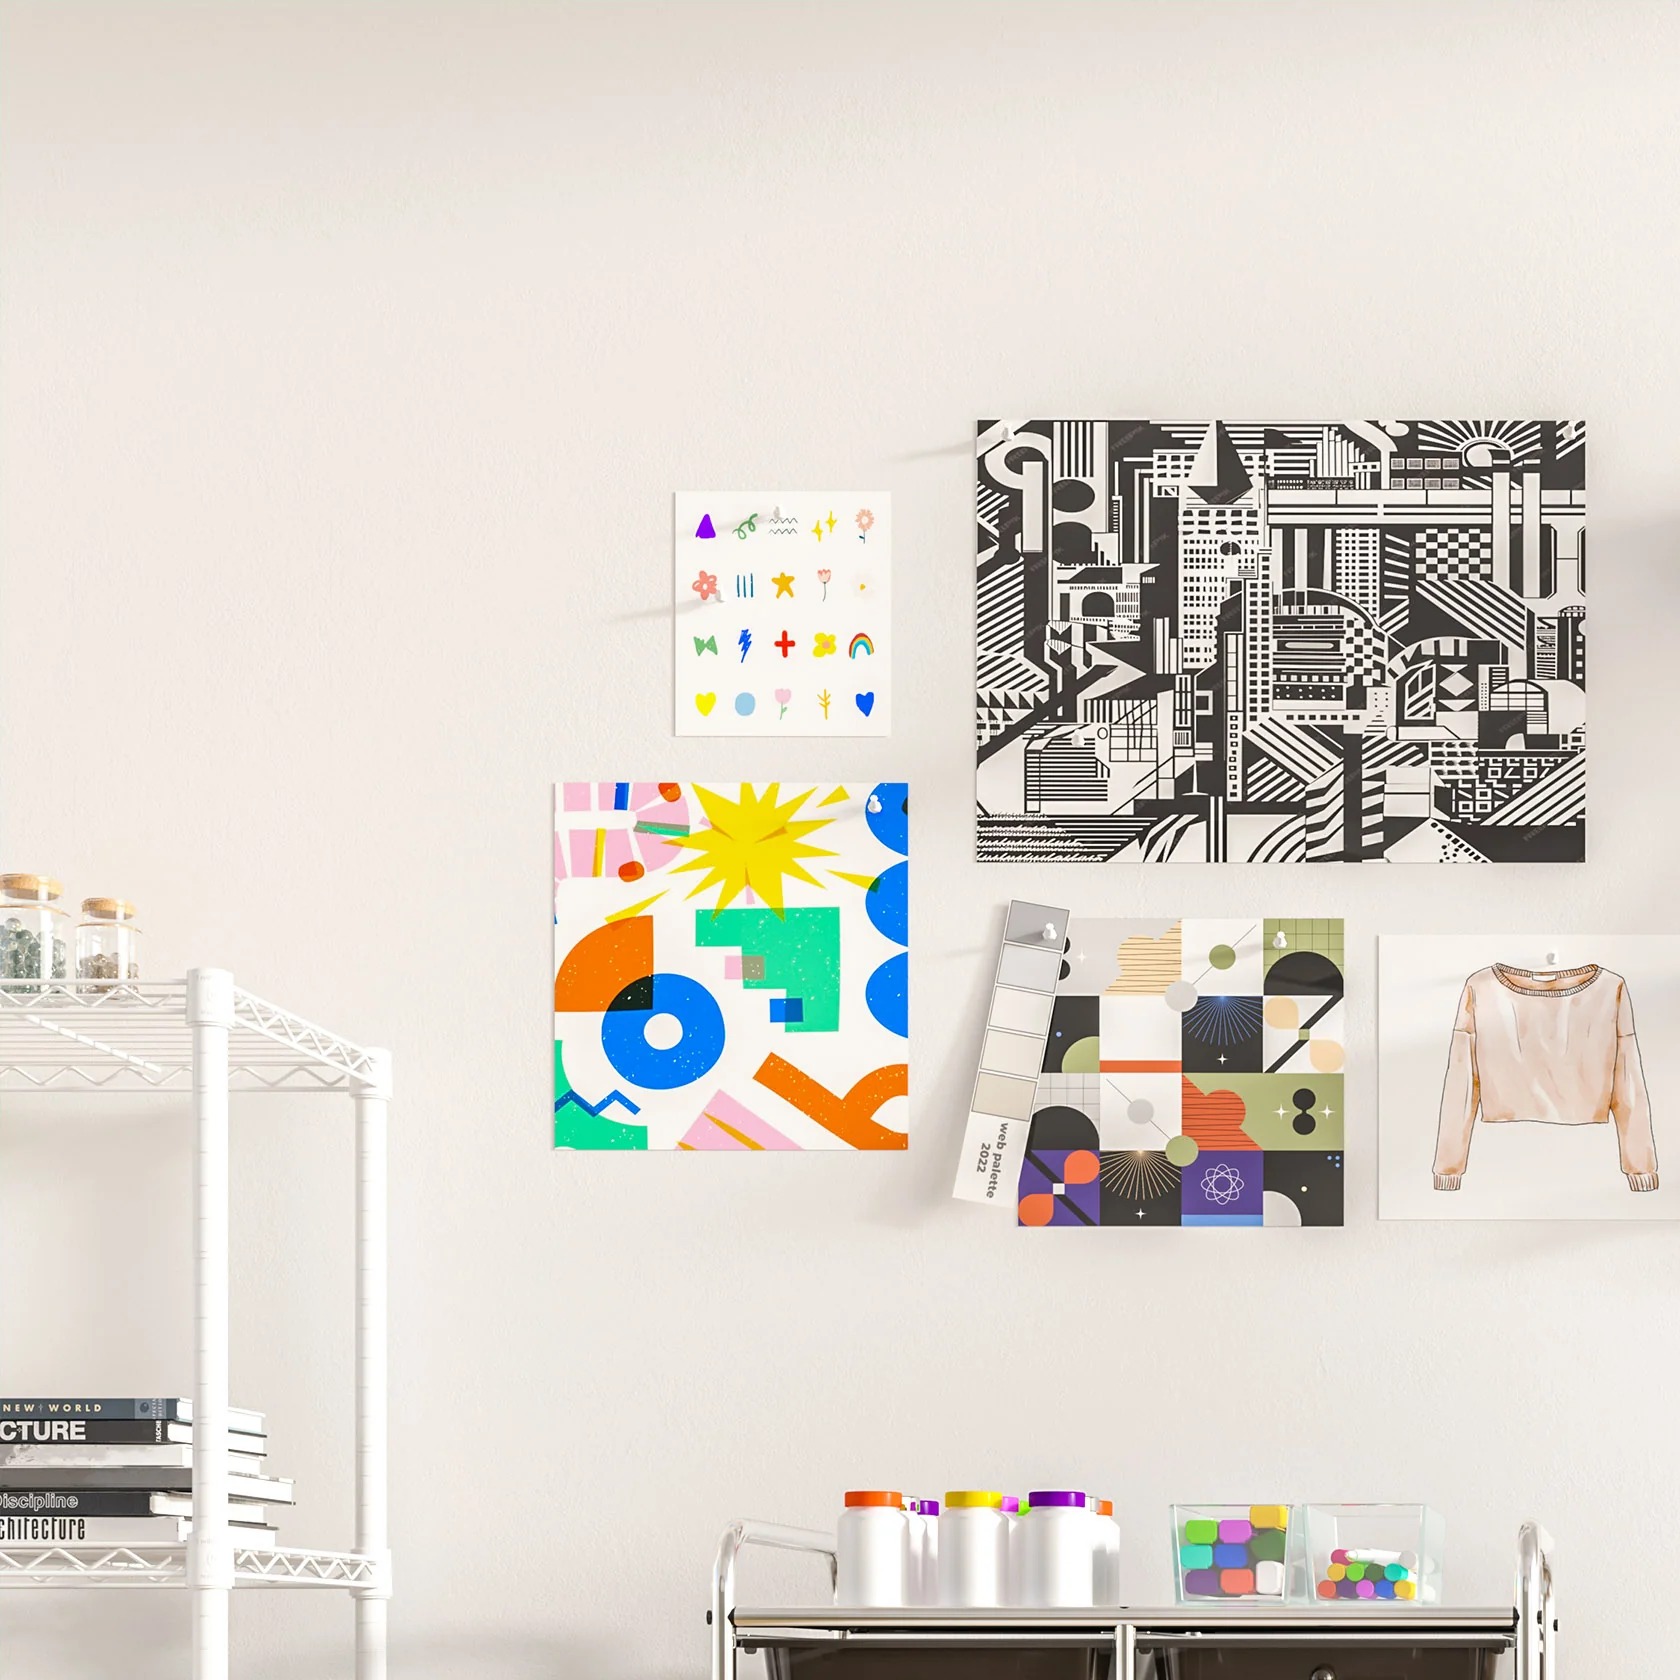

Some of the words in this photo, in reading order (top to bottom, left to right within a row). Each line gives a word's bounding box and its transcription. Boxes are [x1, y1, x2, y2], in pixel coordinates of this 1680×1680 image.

[996, 1122, 1009, 1150] web
[976, 1142, 991, 1174] 2022
[986, 1152, 1002, 1199] palette
[2, 1403, 35, 1413] NEW
[48, 1403, 103, 1413] WORLD
